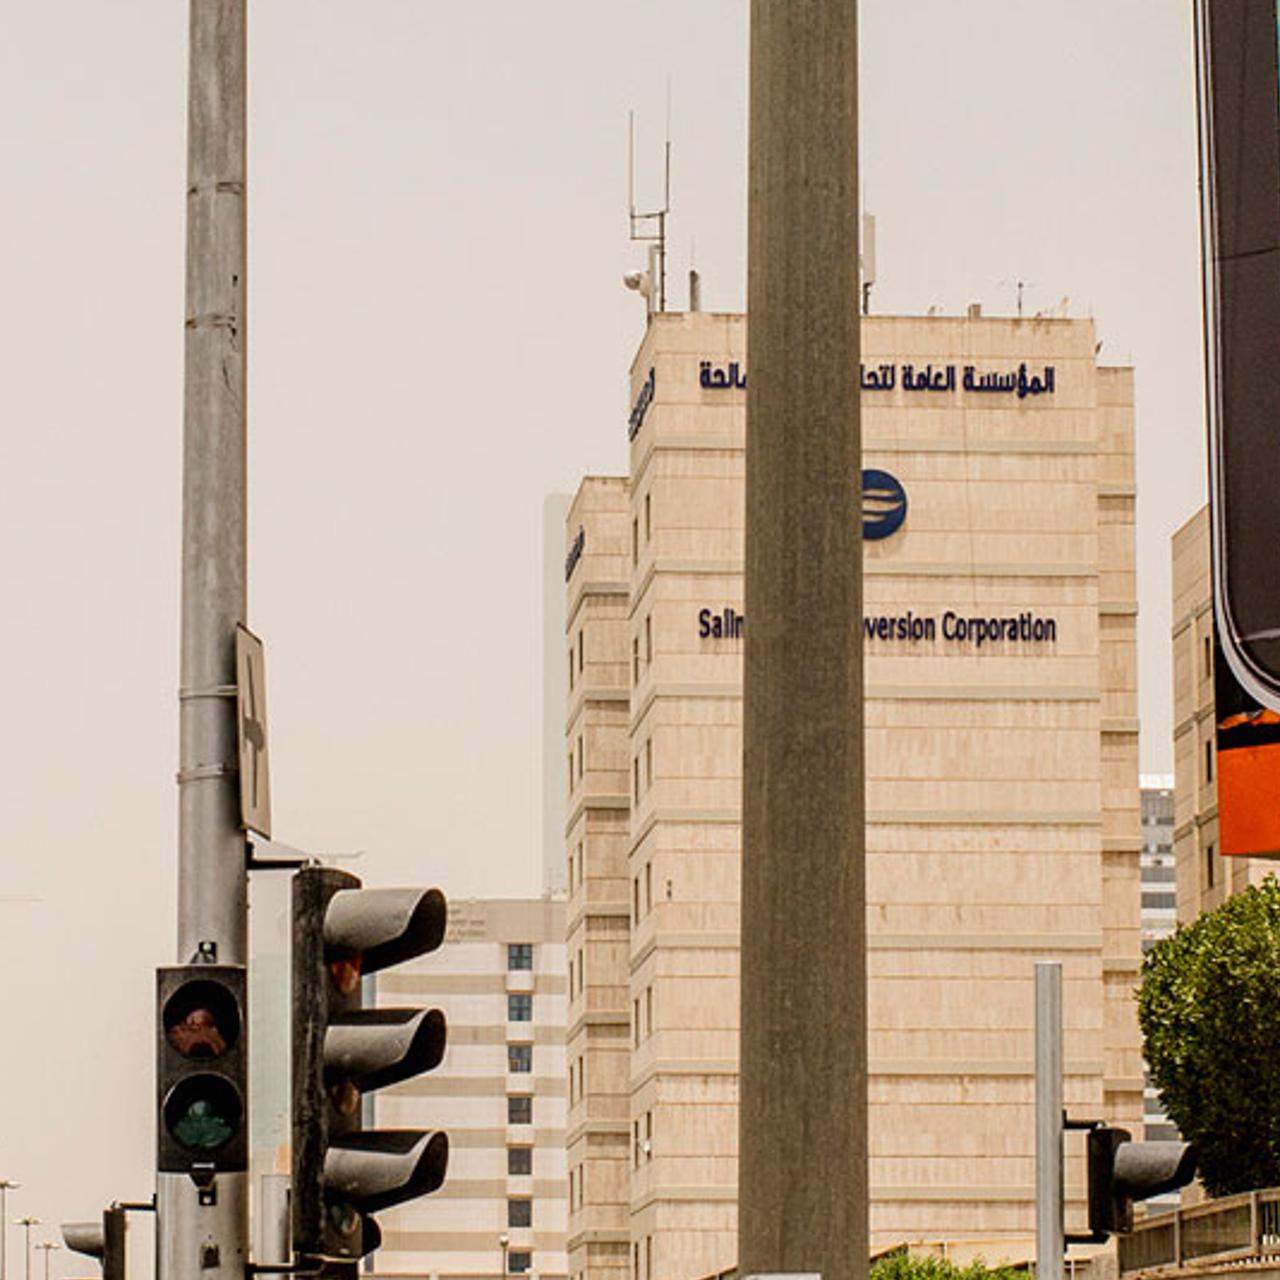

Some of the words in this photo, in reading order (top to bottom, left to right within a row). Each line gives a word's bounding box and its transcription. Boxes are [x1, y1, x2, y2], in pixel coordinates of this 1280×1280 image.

[901, 363, 956, 392] العامة
[962, 363, 1055, 400] المؤسسة
[866, 611, 936, 642] version
[942, 611, 1057, 648] Corporation
